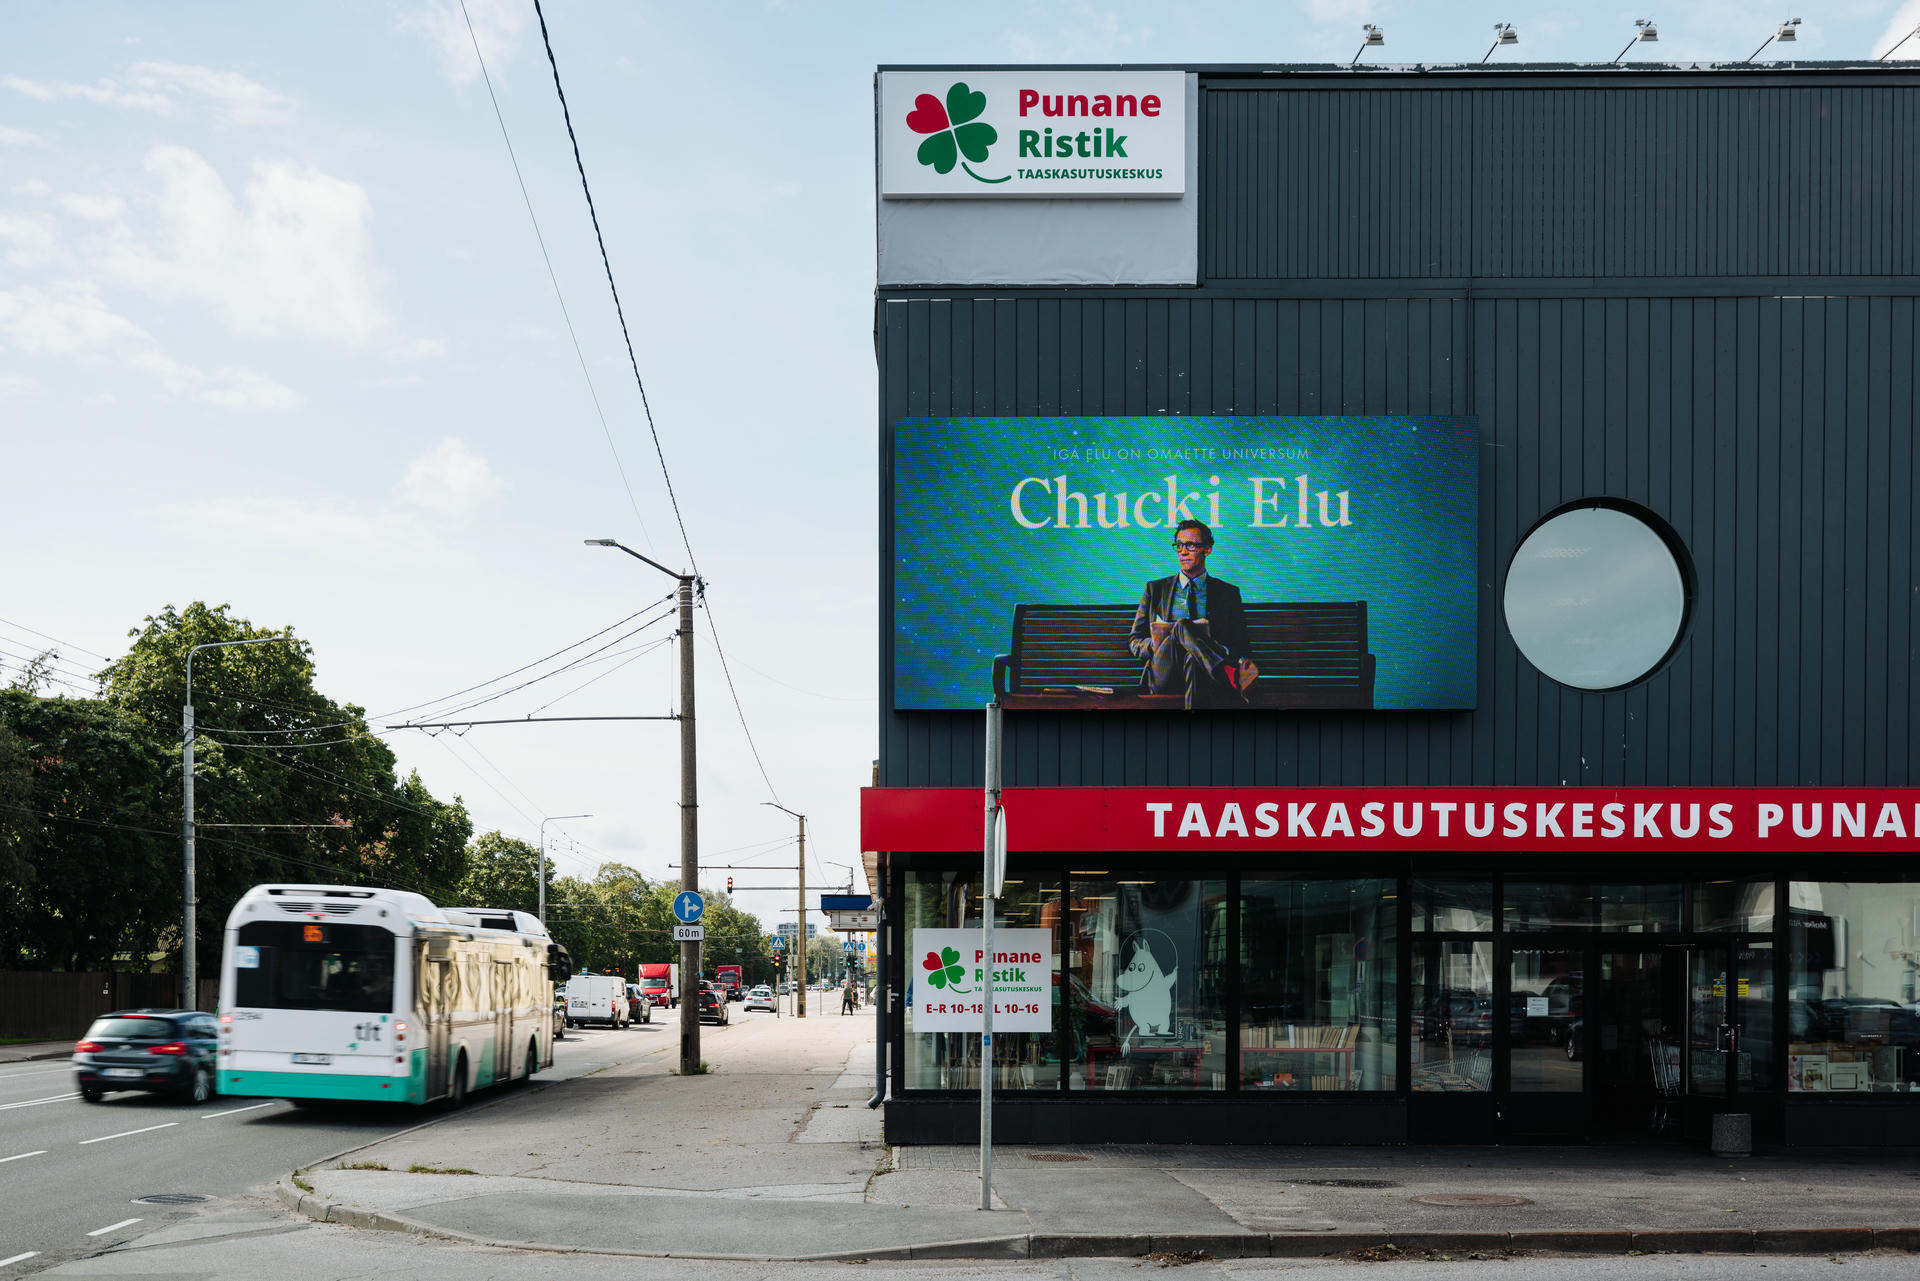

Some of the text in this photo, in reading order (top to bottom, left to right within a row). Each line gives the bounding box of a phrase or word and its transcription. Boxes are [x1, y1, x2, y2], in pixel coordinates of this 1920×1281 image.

[1019, 89, 1161, 117] Punane
[1019, 127, 1128, 158] Ristik
[1017, 168, 1163, 180] TAASKASUTUSKESKUS
[1053, 448, 1310, 460] IGA ELU ON OMAETTE UNIVERSUM
[1010, 473, 1353, 528] Chucki Elu
[1146, 802, 1920, 839] TAASKASUTUSKESKUS PUNA
[975, 949, 1041, 963] Pnane
[975, 968, 1026, 982] Rstik
